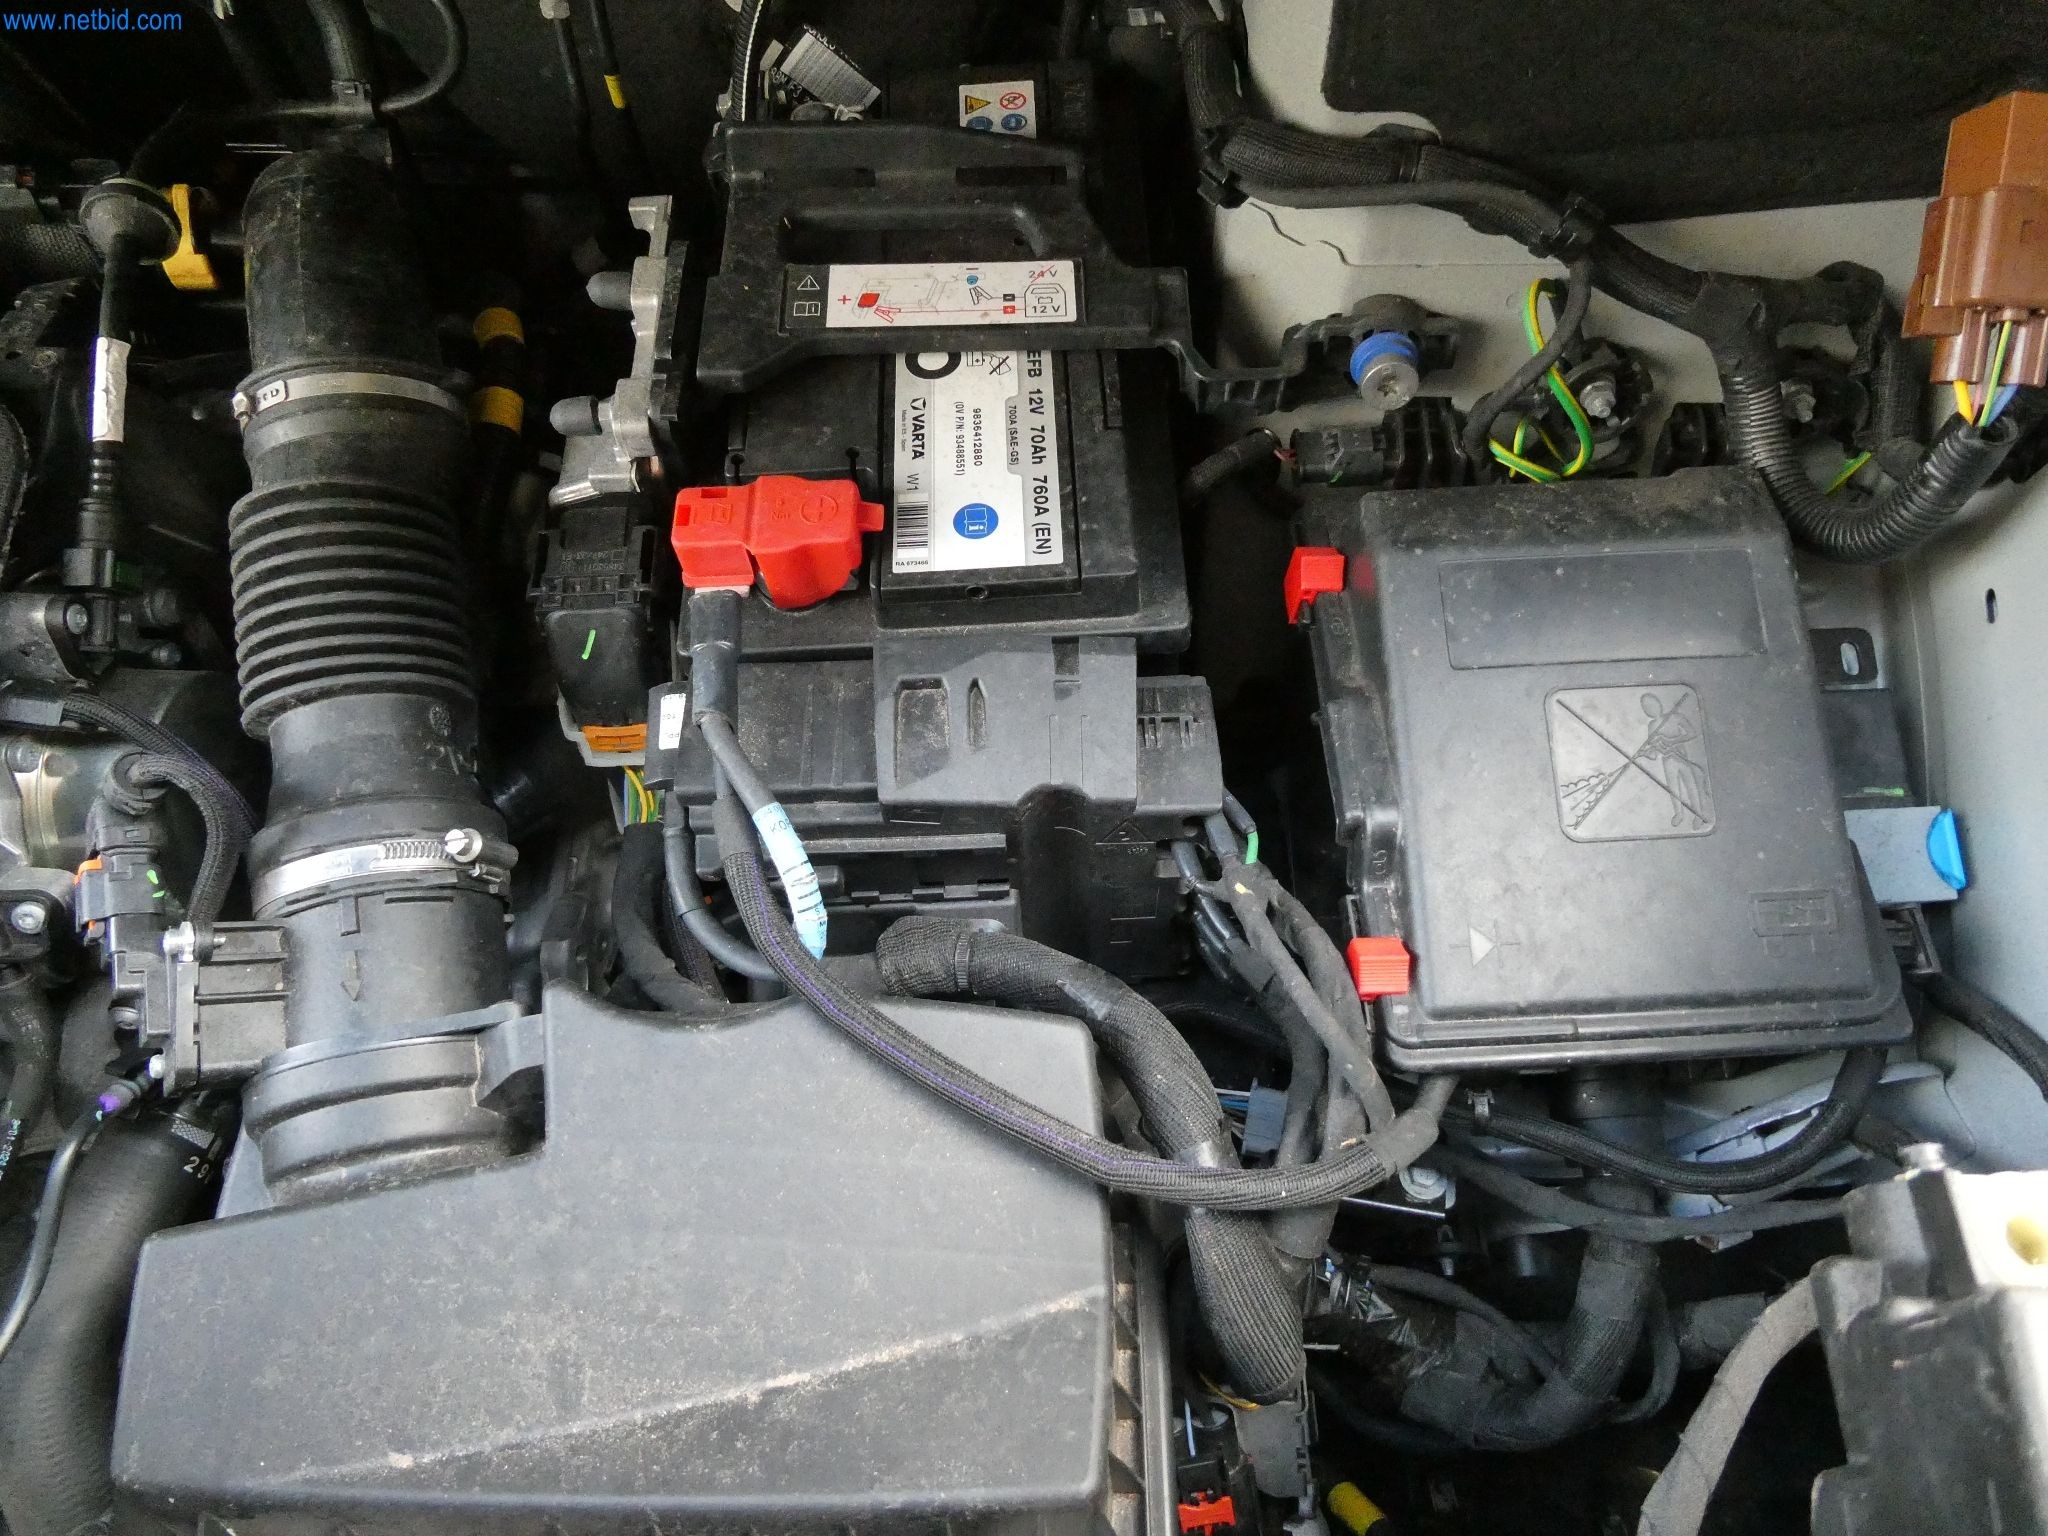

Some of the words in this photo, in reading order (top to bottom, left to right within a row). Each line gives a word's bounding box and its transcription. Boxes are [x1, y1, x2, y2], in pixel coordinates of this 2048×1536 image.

[1028, 270, 1045, 279] 24
[1049, 269, 1058, 278] V
[1032, 305, 1047, 314] 12
[1051, 305, 1061, 314] V
[1027, 350, 1042, 379] EFB
[1008, 405, 1018, 425] 700A
[1029, 388, 1044, 415] 12V
[911, 415, 925, 460] VARTA
[954, 416, 964, 433] P/N:
[973, 407, 982, 467] 9836412880
[954, 434, 965, 476] 93488551)
[1008, 427, 1019, 466] (SAE-GS)
[1030, 425, 1046, 465] 70Ah
[906, 473, 919, 492] W1
[1032, 474, 1049, 517] 760A
[1031, 522, 1052, 555] (EN)
